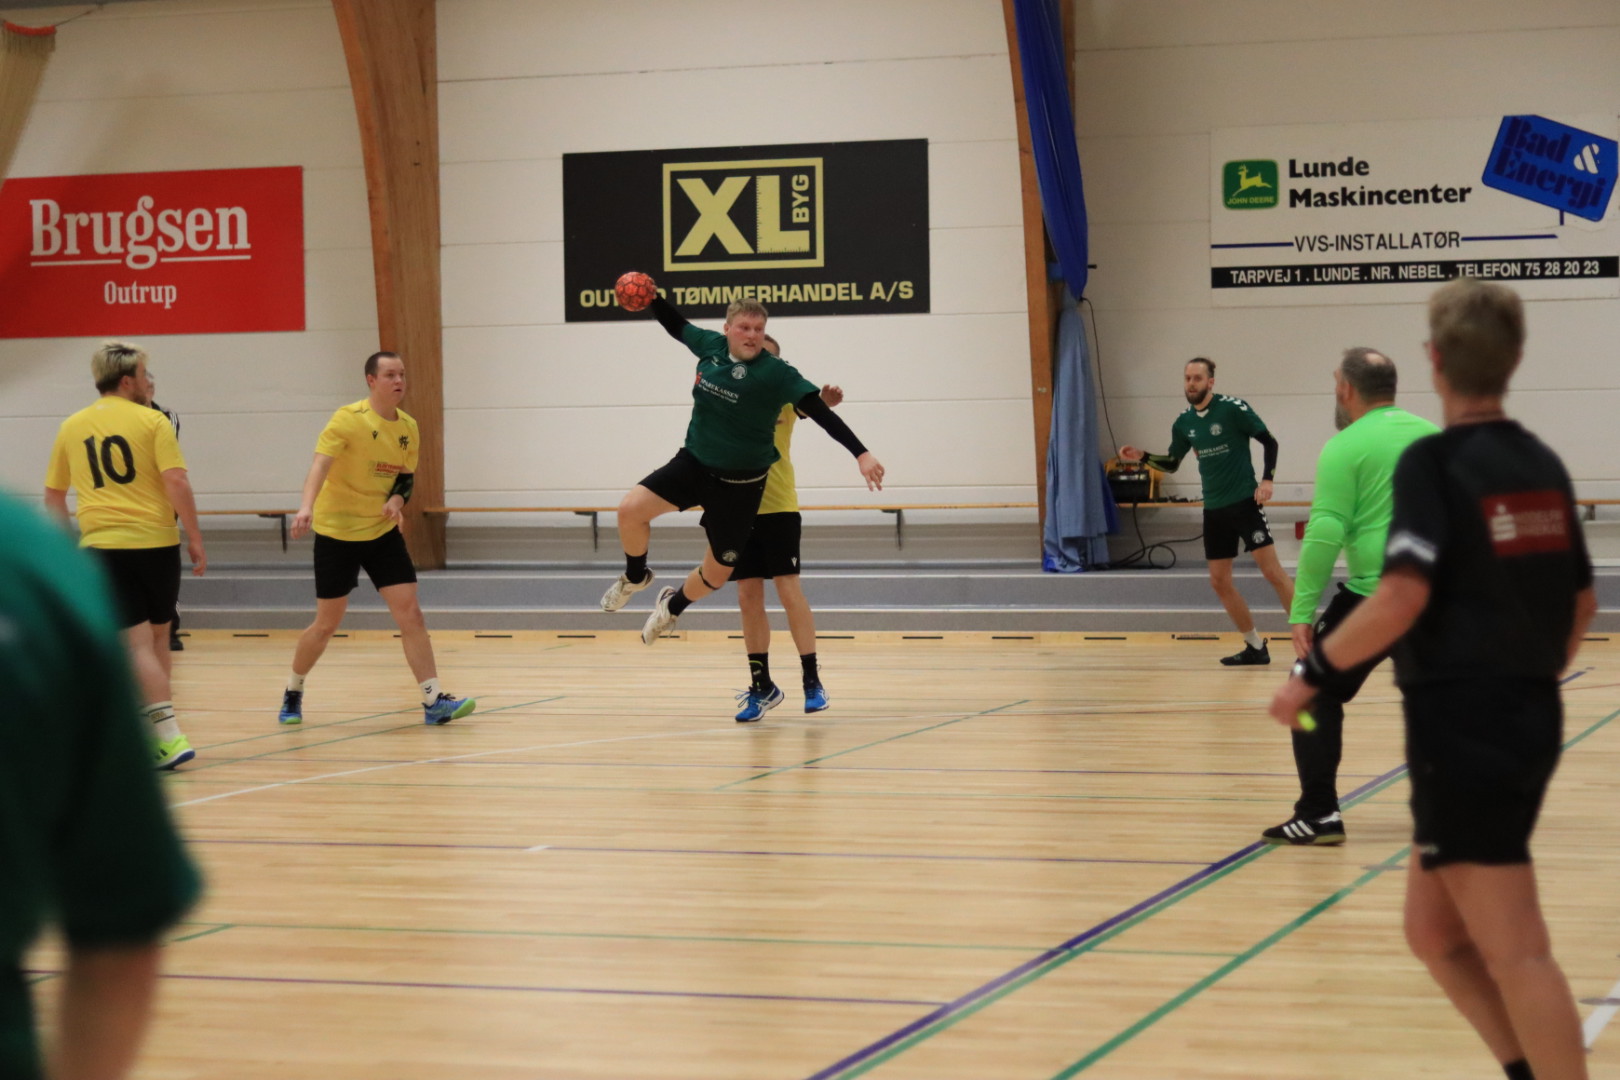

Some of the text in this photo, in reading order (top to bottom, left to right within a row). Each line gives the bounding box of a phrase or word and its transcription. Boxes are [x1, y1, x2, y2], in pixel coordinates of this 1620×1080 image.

[1503, 116, 1572, 164] Bad
[1288, 157, 1370, 179] Lunde
[1493, 147, 1606, 209] Energi
[791, 174, 810, 223] BYG
[1226, 197, 1248, 205] JOHN
[1288, 184, 1473, 208] Maskincenter
[674, 175, 810, 256] XL
[29, 195, 251, 270] Brugsen
[1294, 231, 1461, 252] VVS-INSTALLATØR
[1230, 260, 1600, 284] TARPVEJ 1 LUNDE NR. NEBEL TELEFON 75 28 20 23
[104, 281, 177, 309] Outrup
[672, 283, 864, 306] TØMMERHANDEL
[869, 280, 915, 302] A/S
[83, 434, 136, 489] 10
